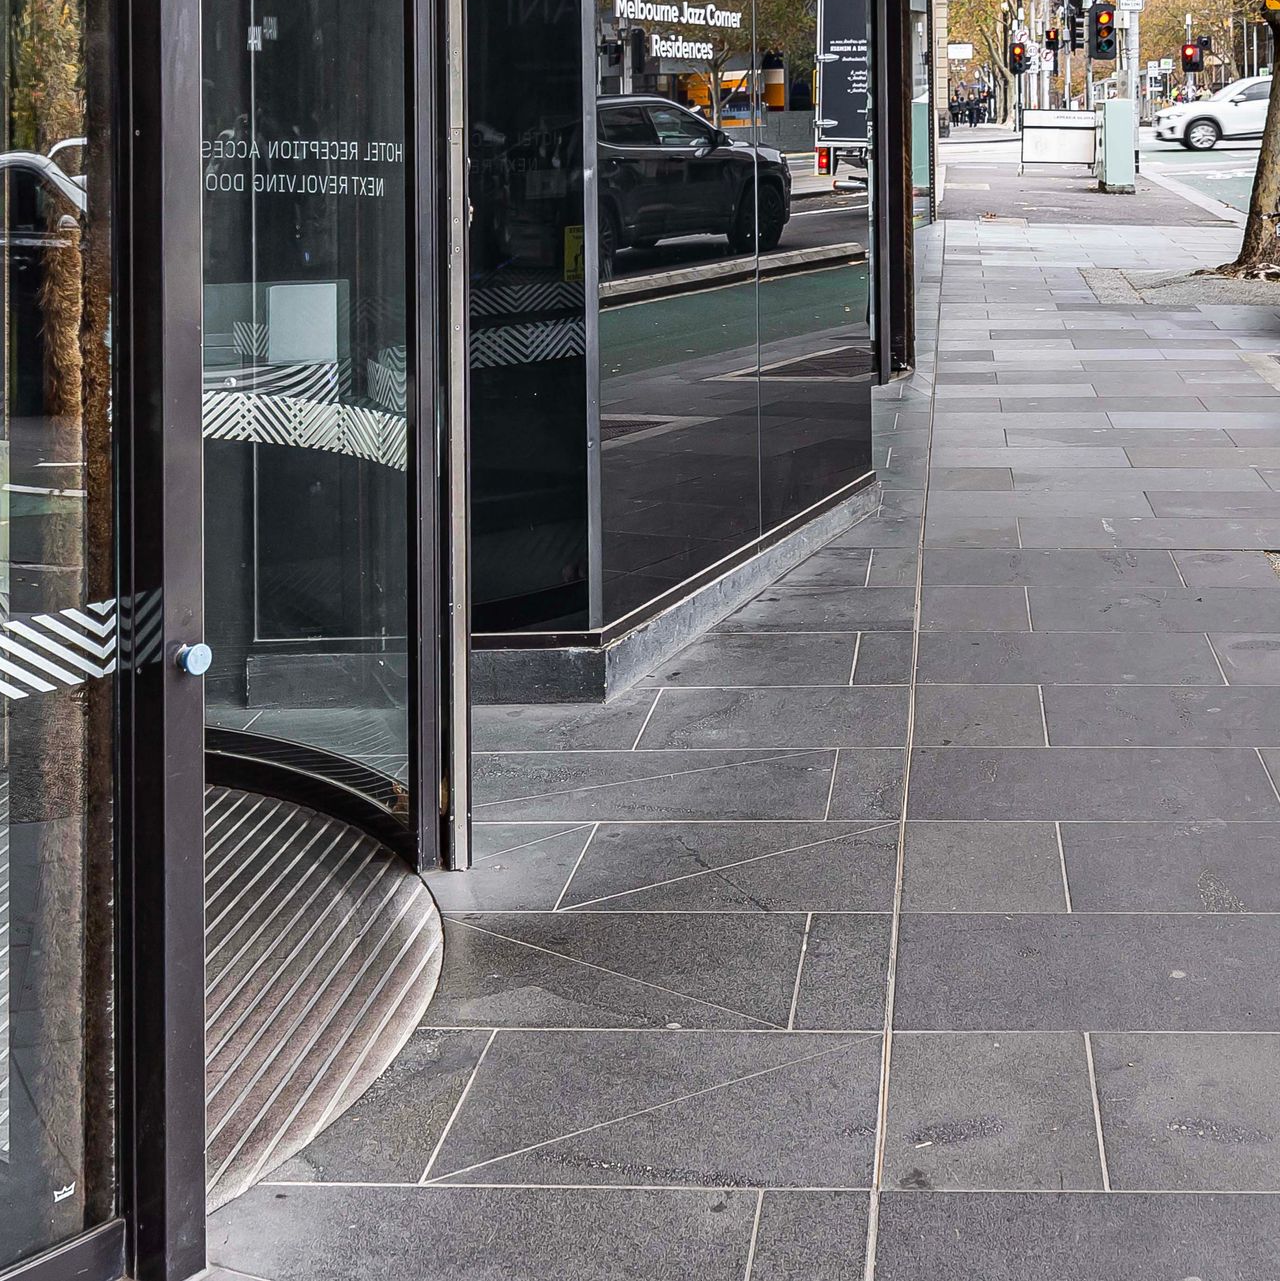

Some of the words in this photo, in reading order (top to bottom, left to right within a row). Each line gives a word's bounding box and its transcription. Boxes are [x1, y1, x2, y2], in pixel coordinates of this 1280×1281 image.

[680, 1, 706, 25] Jazz
[706, 4, 742, 28] Corner
[651, 34, 714, 60] Residences
